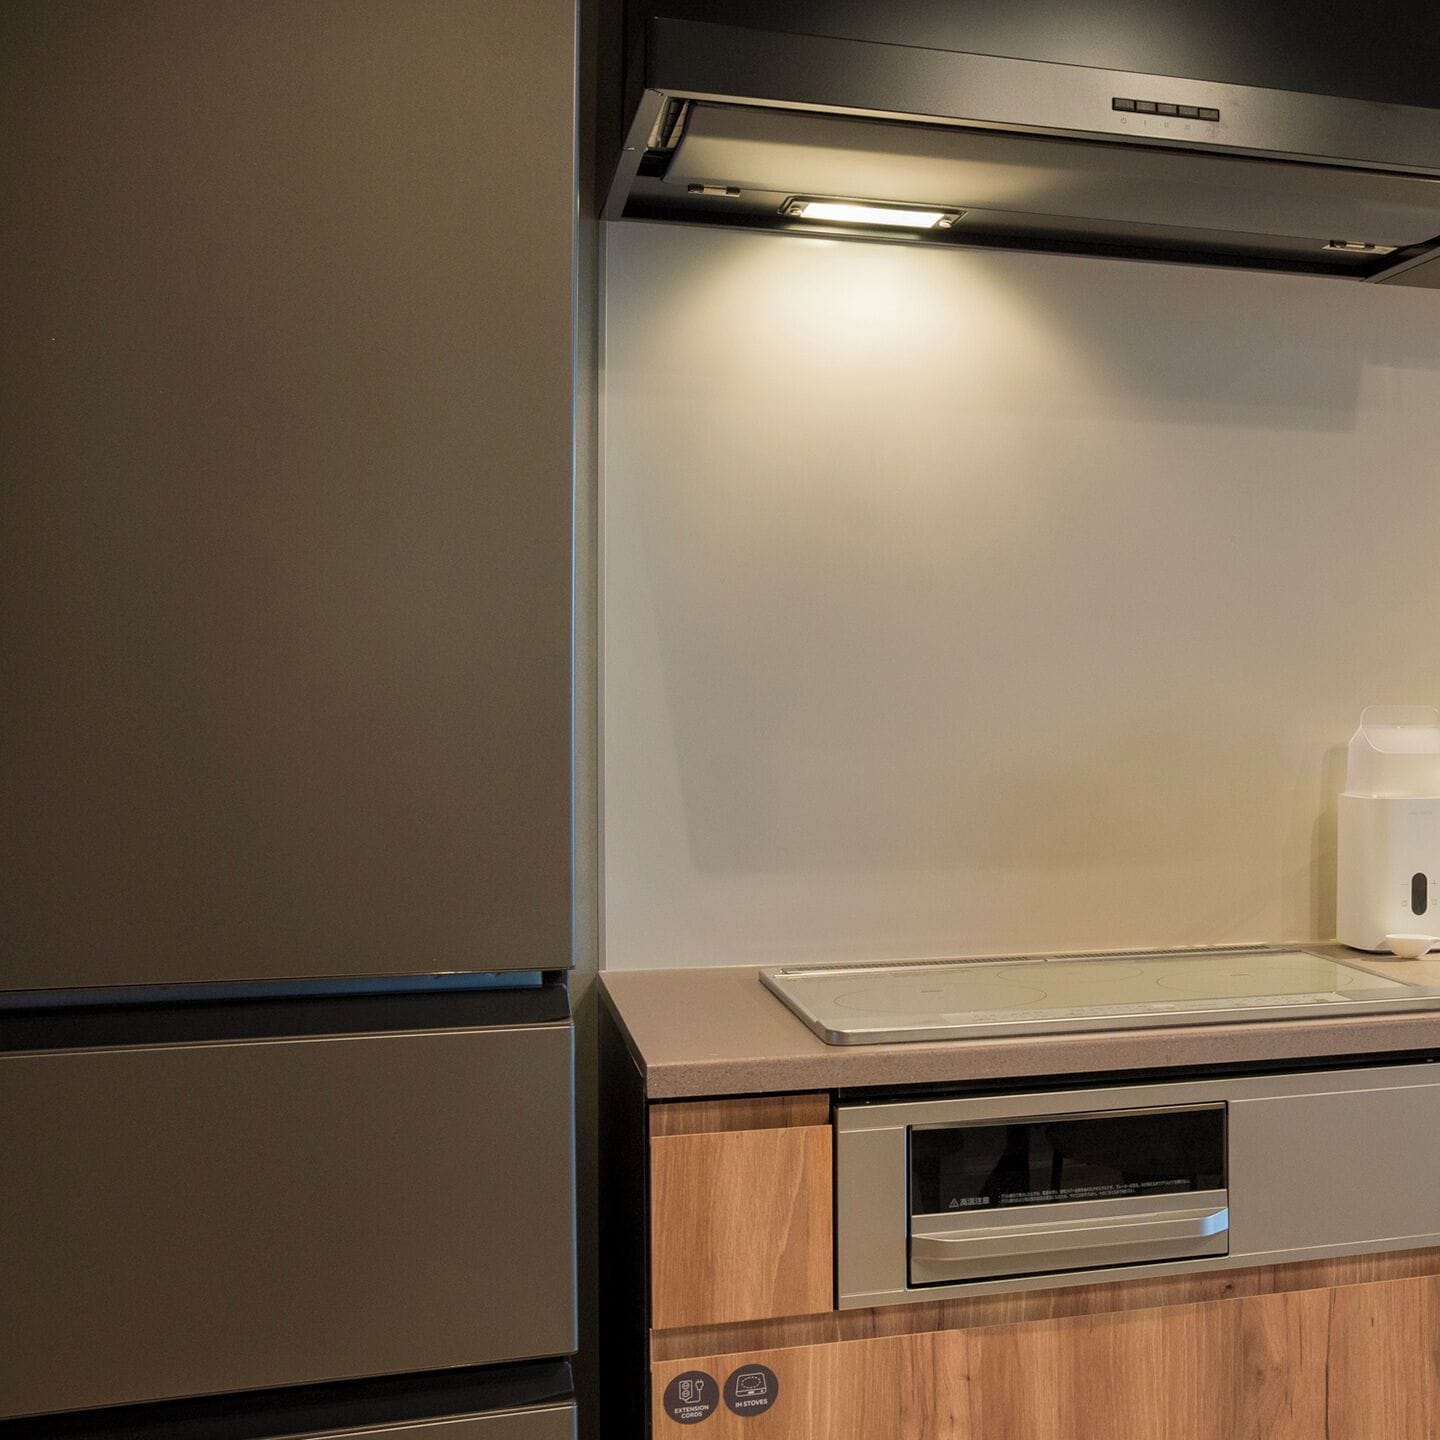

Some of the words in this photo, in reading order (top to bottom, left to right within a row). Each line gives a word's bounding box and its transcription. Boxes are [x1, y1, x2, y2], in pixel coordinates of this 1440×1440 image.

[744, 1398, 768, 1407] STOVES
[674, 1405, 709, 1413] EXTENSION
[681, 1411, 703, 1419] CORDS
